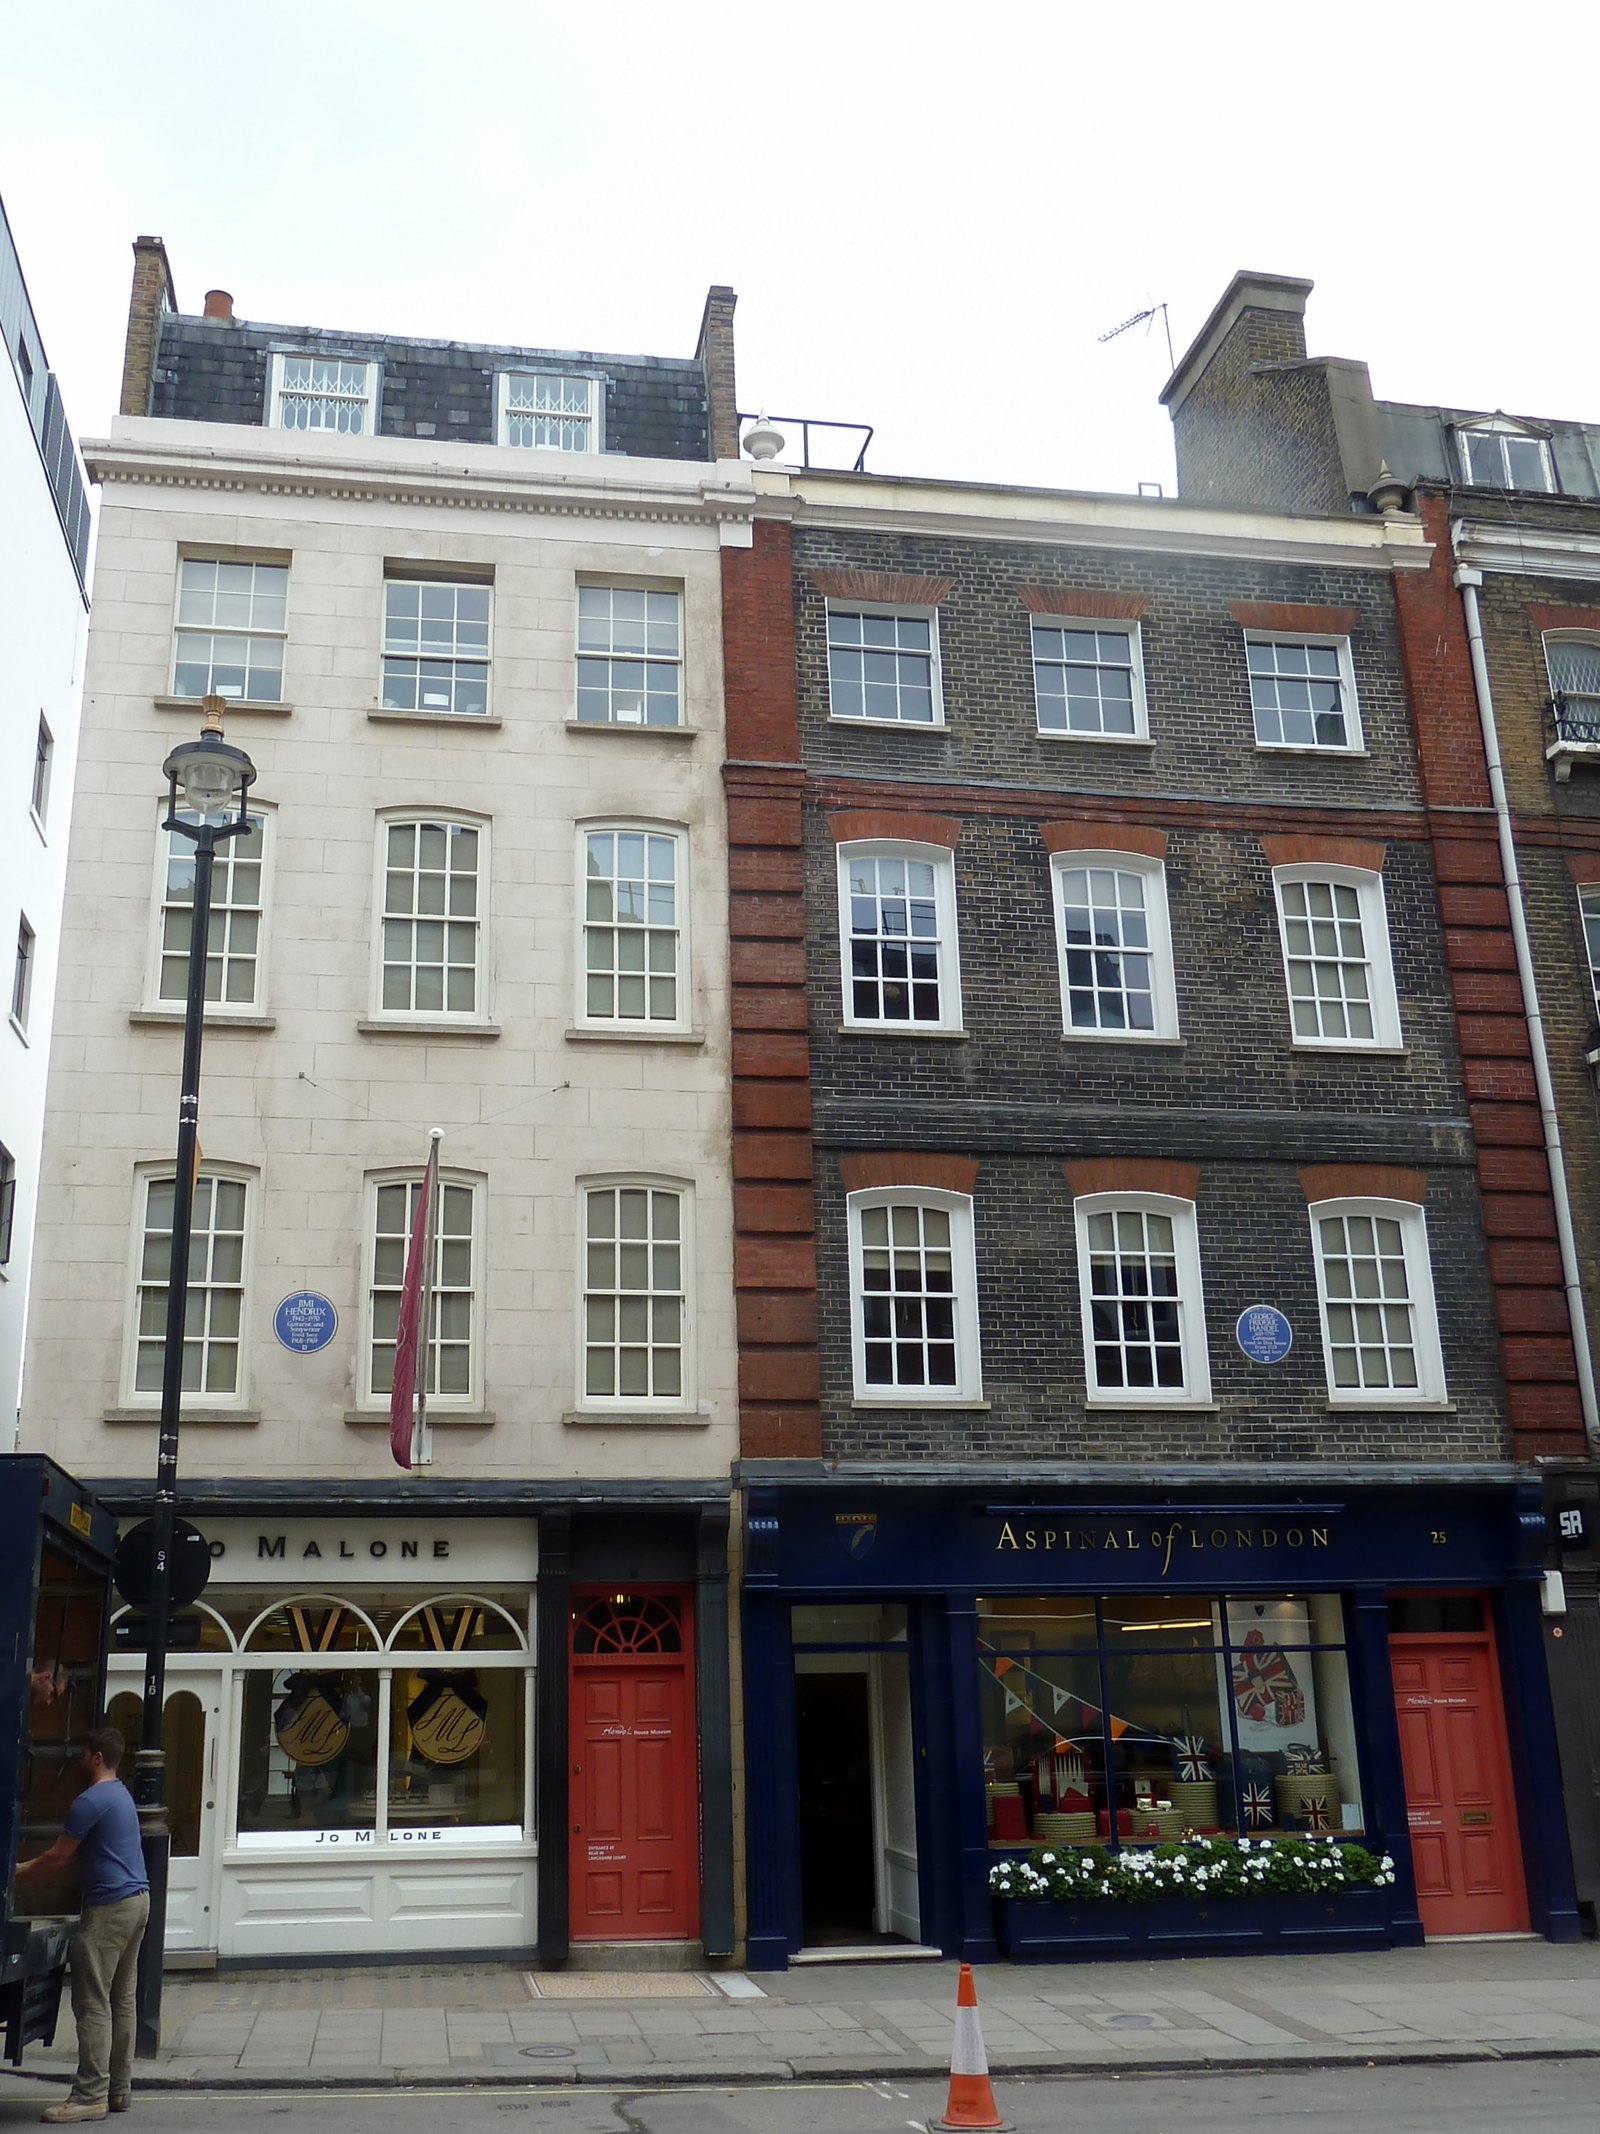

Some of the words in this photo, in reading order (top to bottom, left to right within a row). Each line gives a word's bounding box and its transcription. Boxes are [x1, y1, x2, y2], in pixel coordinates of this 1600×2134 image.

[285, 1307, 326, 1316] HENDRIX
[1249, 1324, 1280, 1332] HANDEL
[1430, 1531, 1447, 1544] 25
[208, 1541, 226, 1557] O
[257, 1536, 450, 1558] MALONE
[995, 1521, 1140, 1550] ASPINAL
[1151, 1523, 1182, 1576] of
[1191, 1528, 1329, 1549] LONDON
[355, 1831, 441, 1843] MLONE
